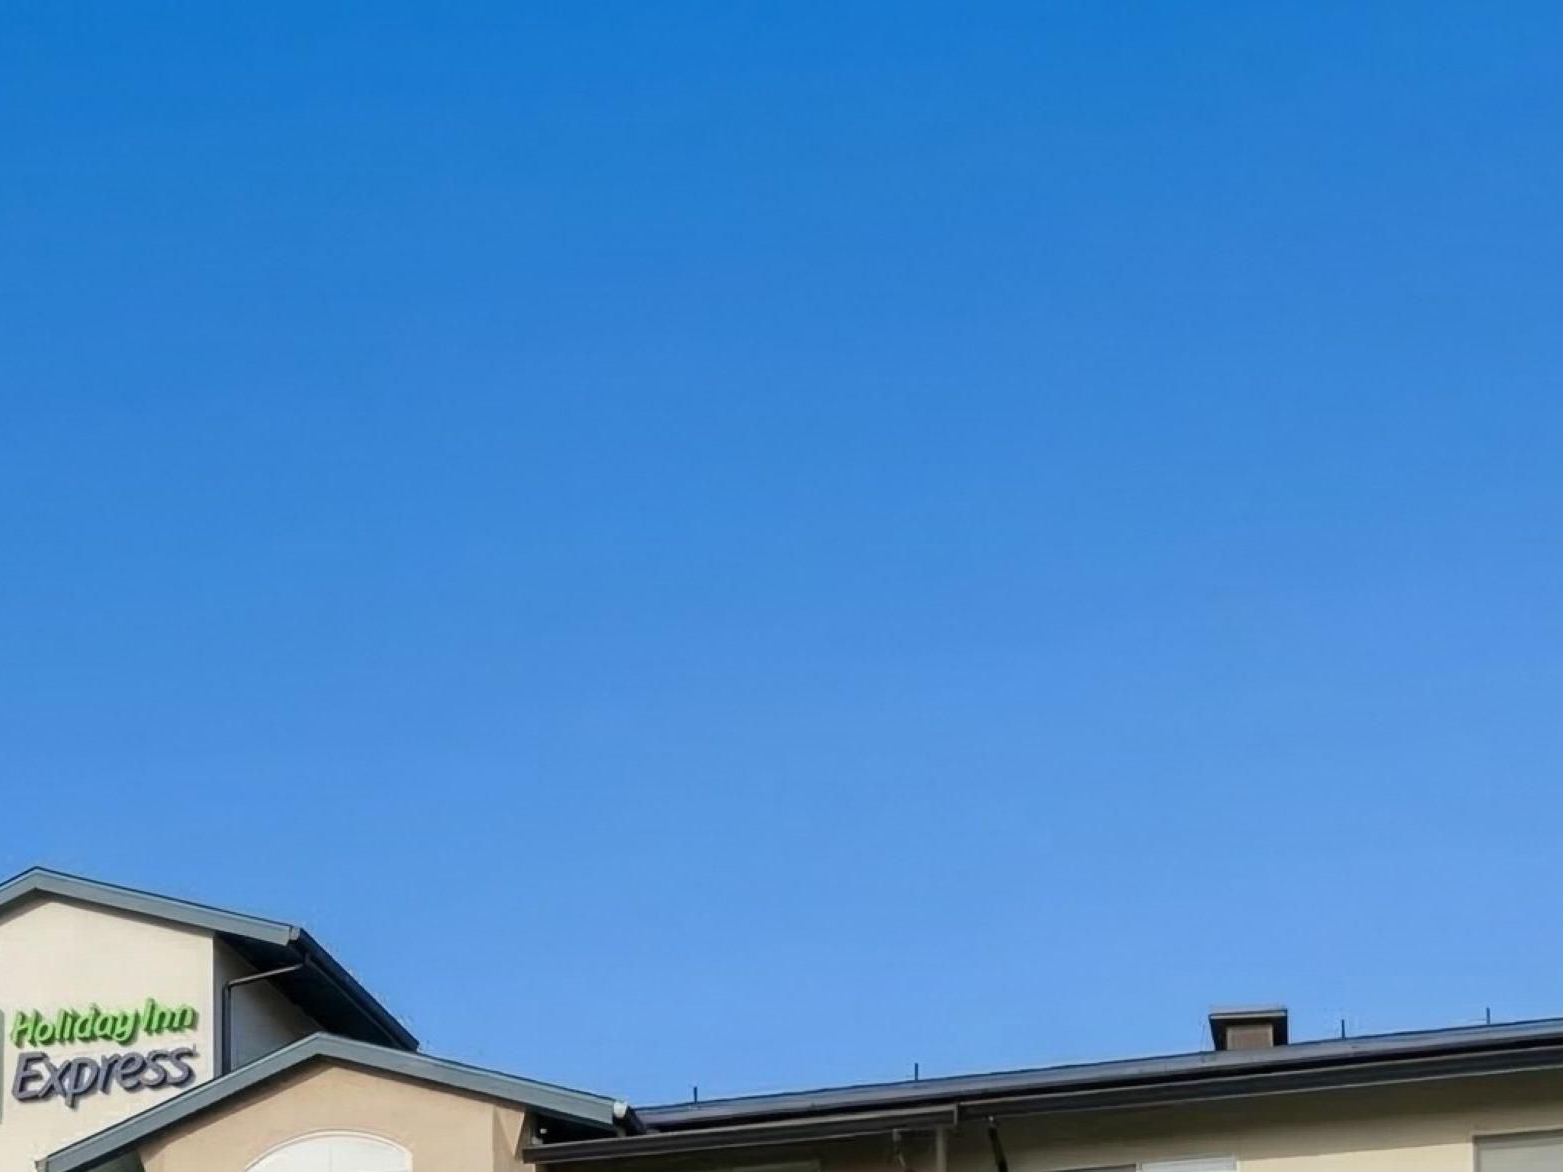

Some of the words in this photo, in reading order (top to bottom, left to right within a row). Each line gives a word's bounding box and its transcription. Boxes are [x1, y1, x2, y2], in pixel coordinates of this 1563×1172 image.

[10, 1006, 137, 1047] Holiday
[142, 999, 197, 1033] Inn
[12, 1047, 196, 1109] Express
